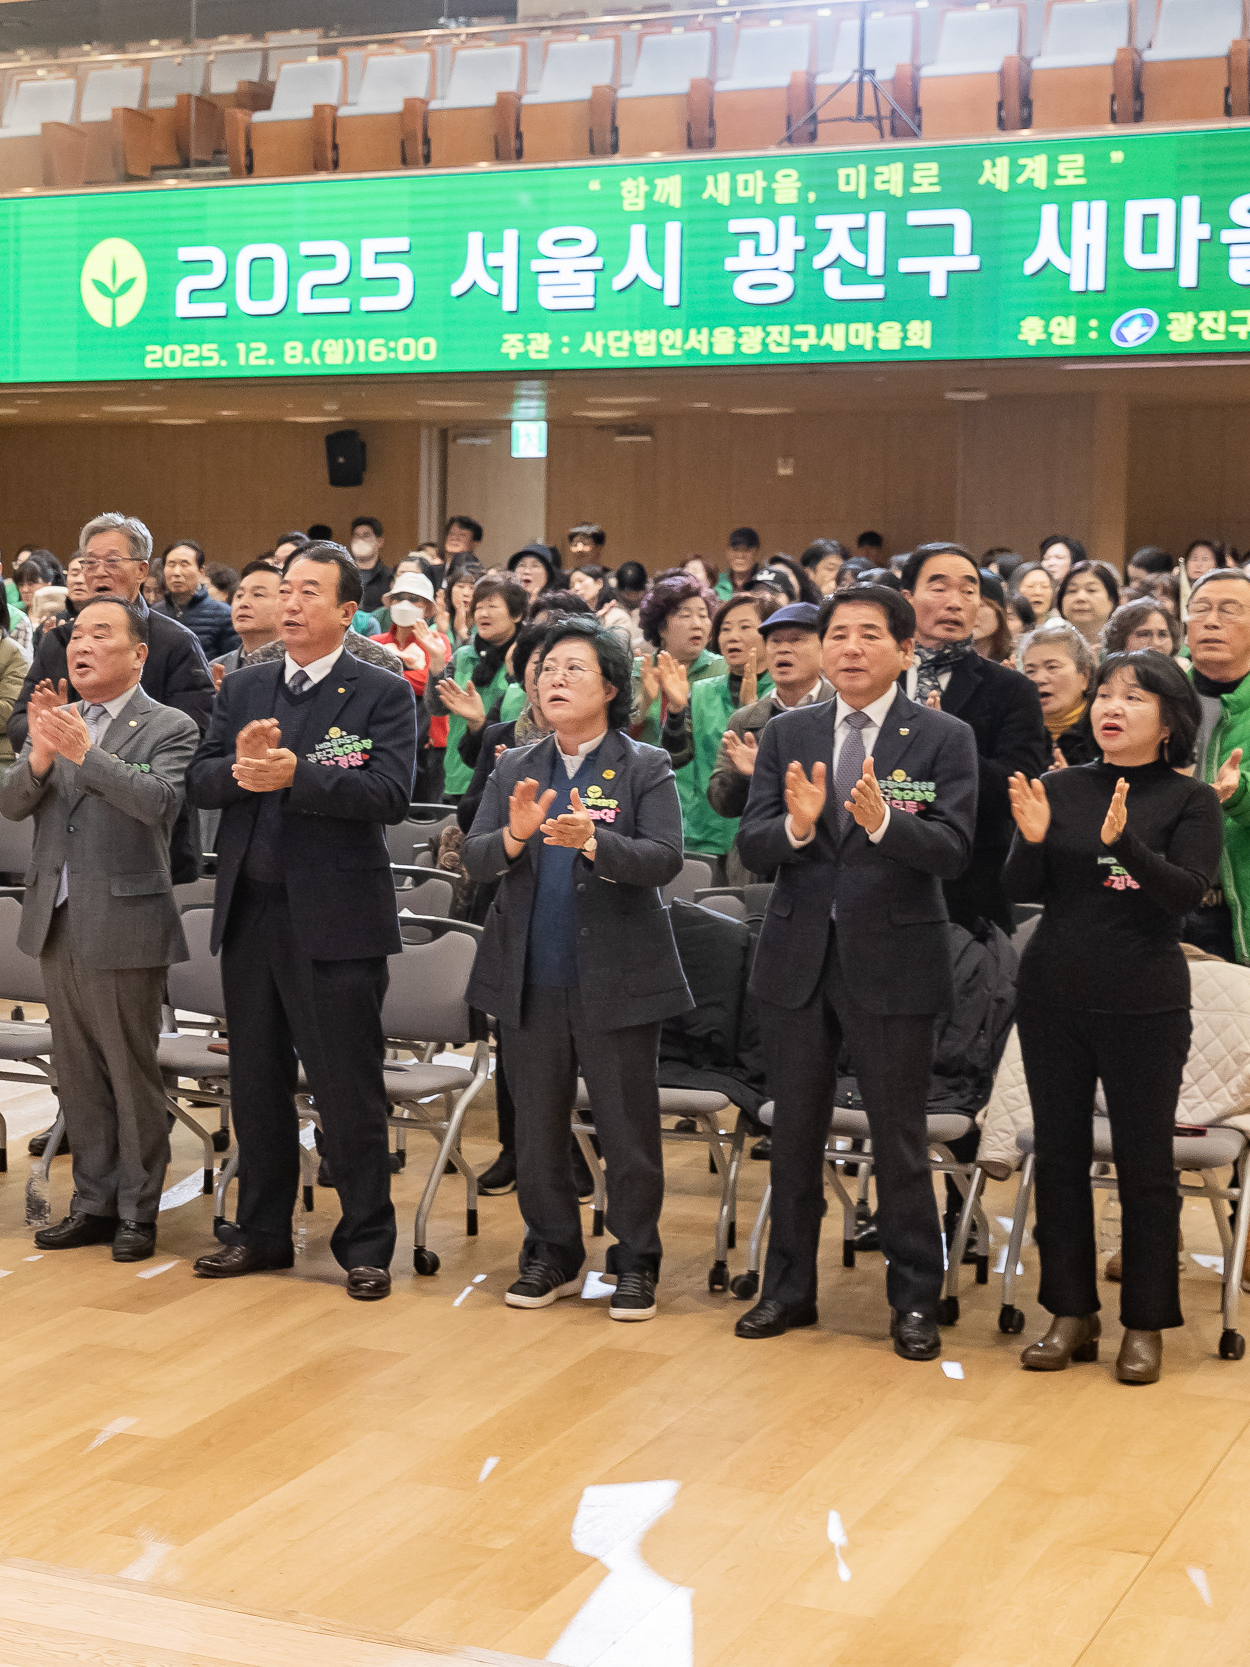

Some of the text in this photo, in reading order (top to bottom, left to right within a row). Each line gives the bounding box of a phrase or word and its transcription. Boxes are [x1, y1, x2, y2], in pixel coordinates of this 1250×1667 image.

[620, 174, 682, 211] 함께
[701, 168, 816, 206] 새마을,
[837, 161, 941, 200] 미래로
[978, 153, 1087, 192] 세계로
[175, 236, 414, 318] 2025
[450, 220, 682, 312] 서울시
[724, 208, 980, 304] 광진구
[500, 332, 553, 360] 주관
[579, 319, 932, 358] 사단법인서울광진구새마을회
[1017, 315, 1077, 346] 후원
[144, 344, 227, 369] 2025.
[236, 342, 275, 366] 12.
